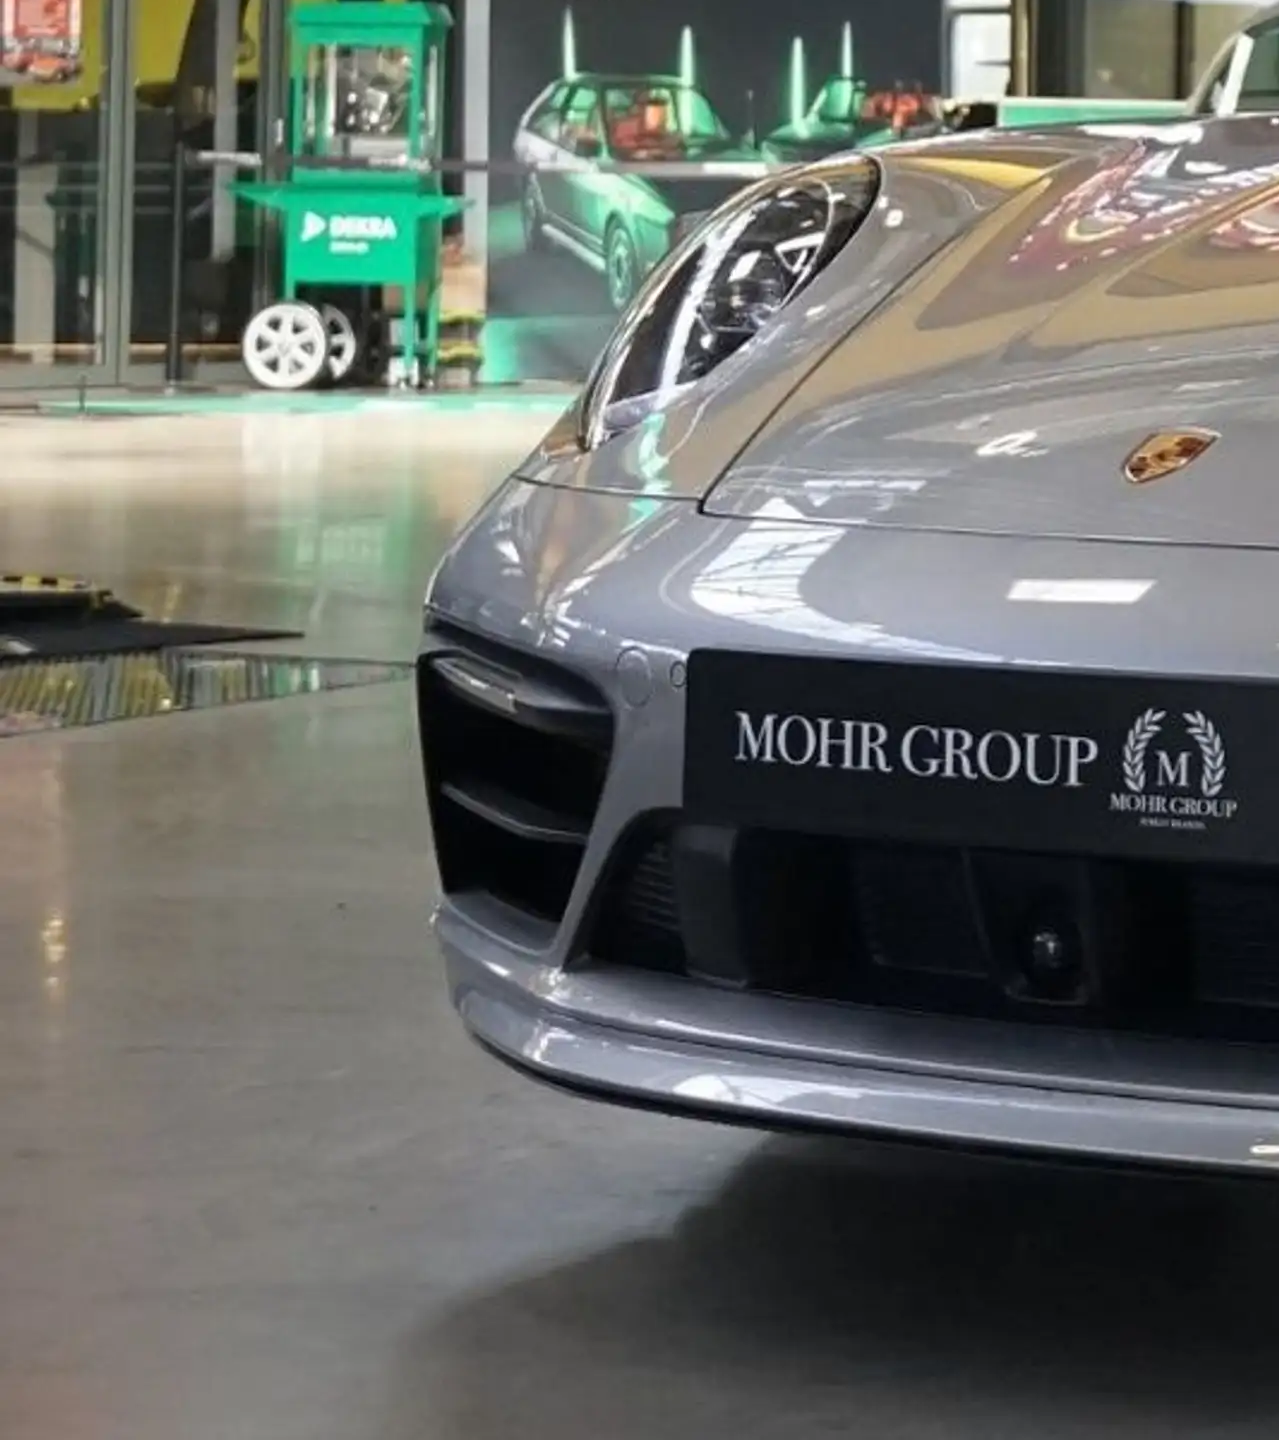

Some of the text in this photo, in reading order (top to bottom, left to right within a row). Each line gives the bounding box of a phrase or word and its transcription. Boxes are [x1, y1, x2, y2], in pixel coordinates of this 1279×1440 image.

[330, 215, 397, 241] DEKRA
[734, 711, 1098, 787] MOHR GROUP
[1155, 749, 1193, 787] M
[1110, 792, 1238, 819] MOHR GROUP
